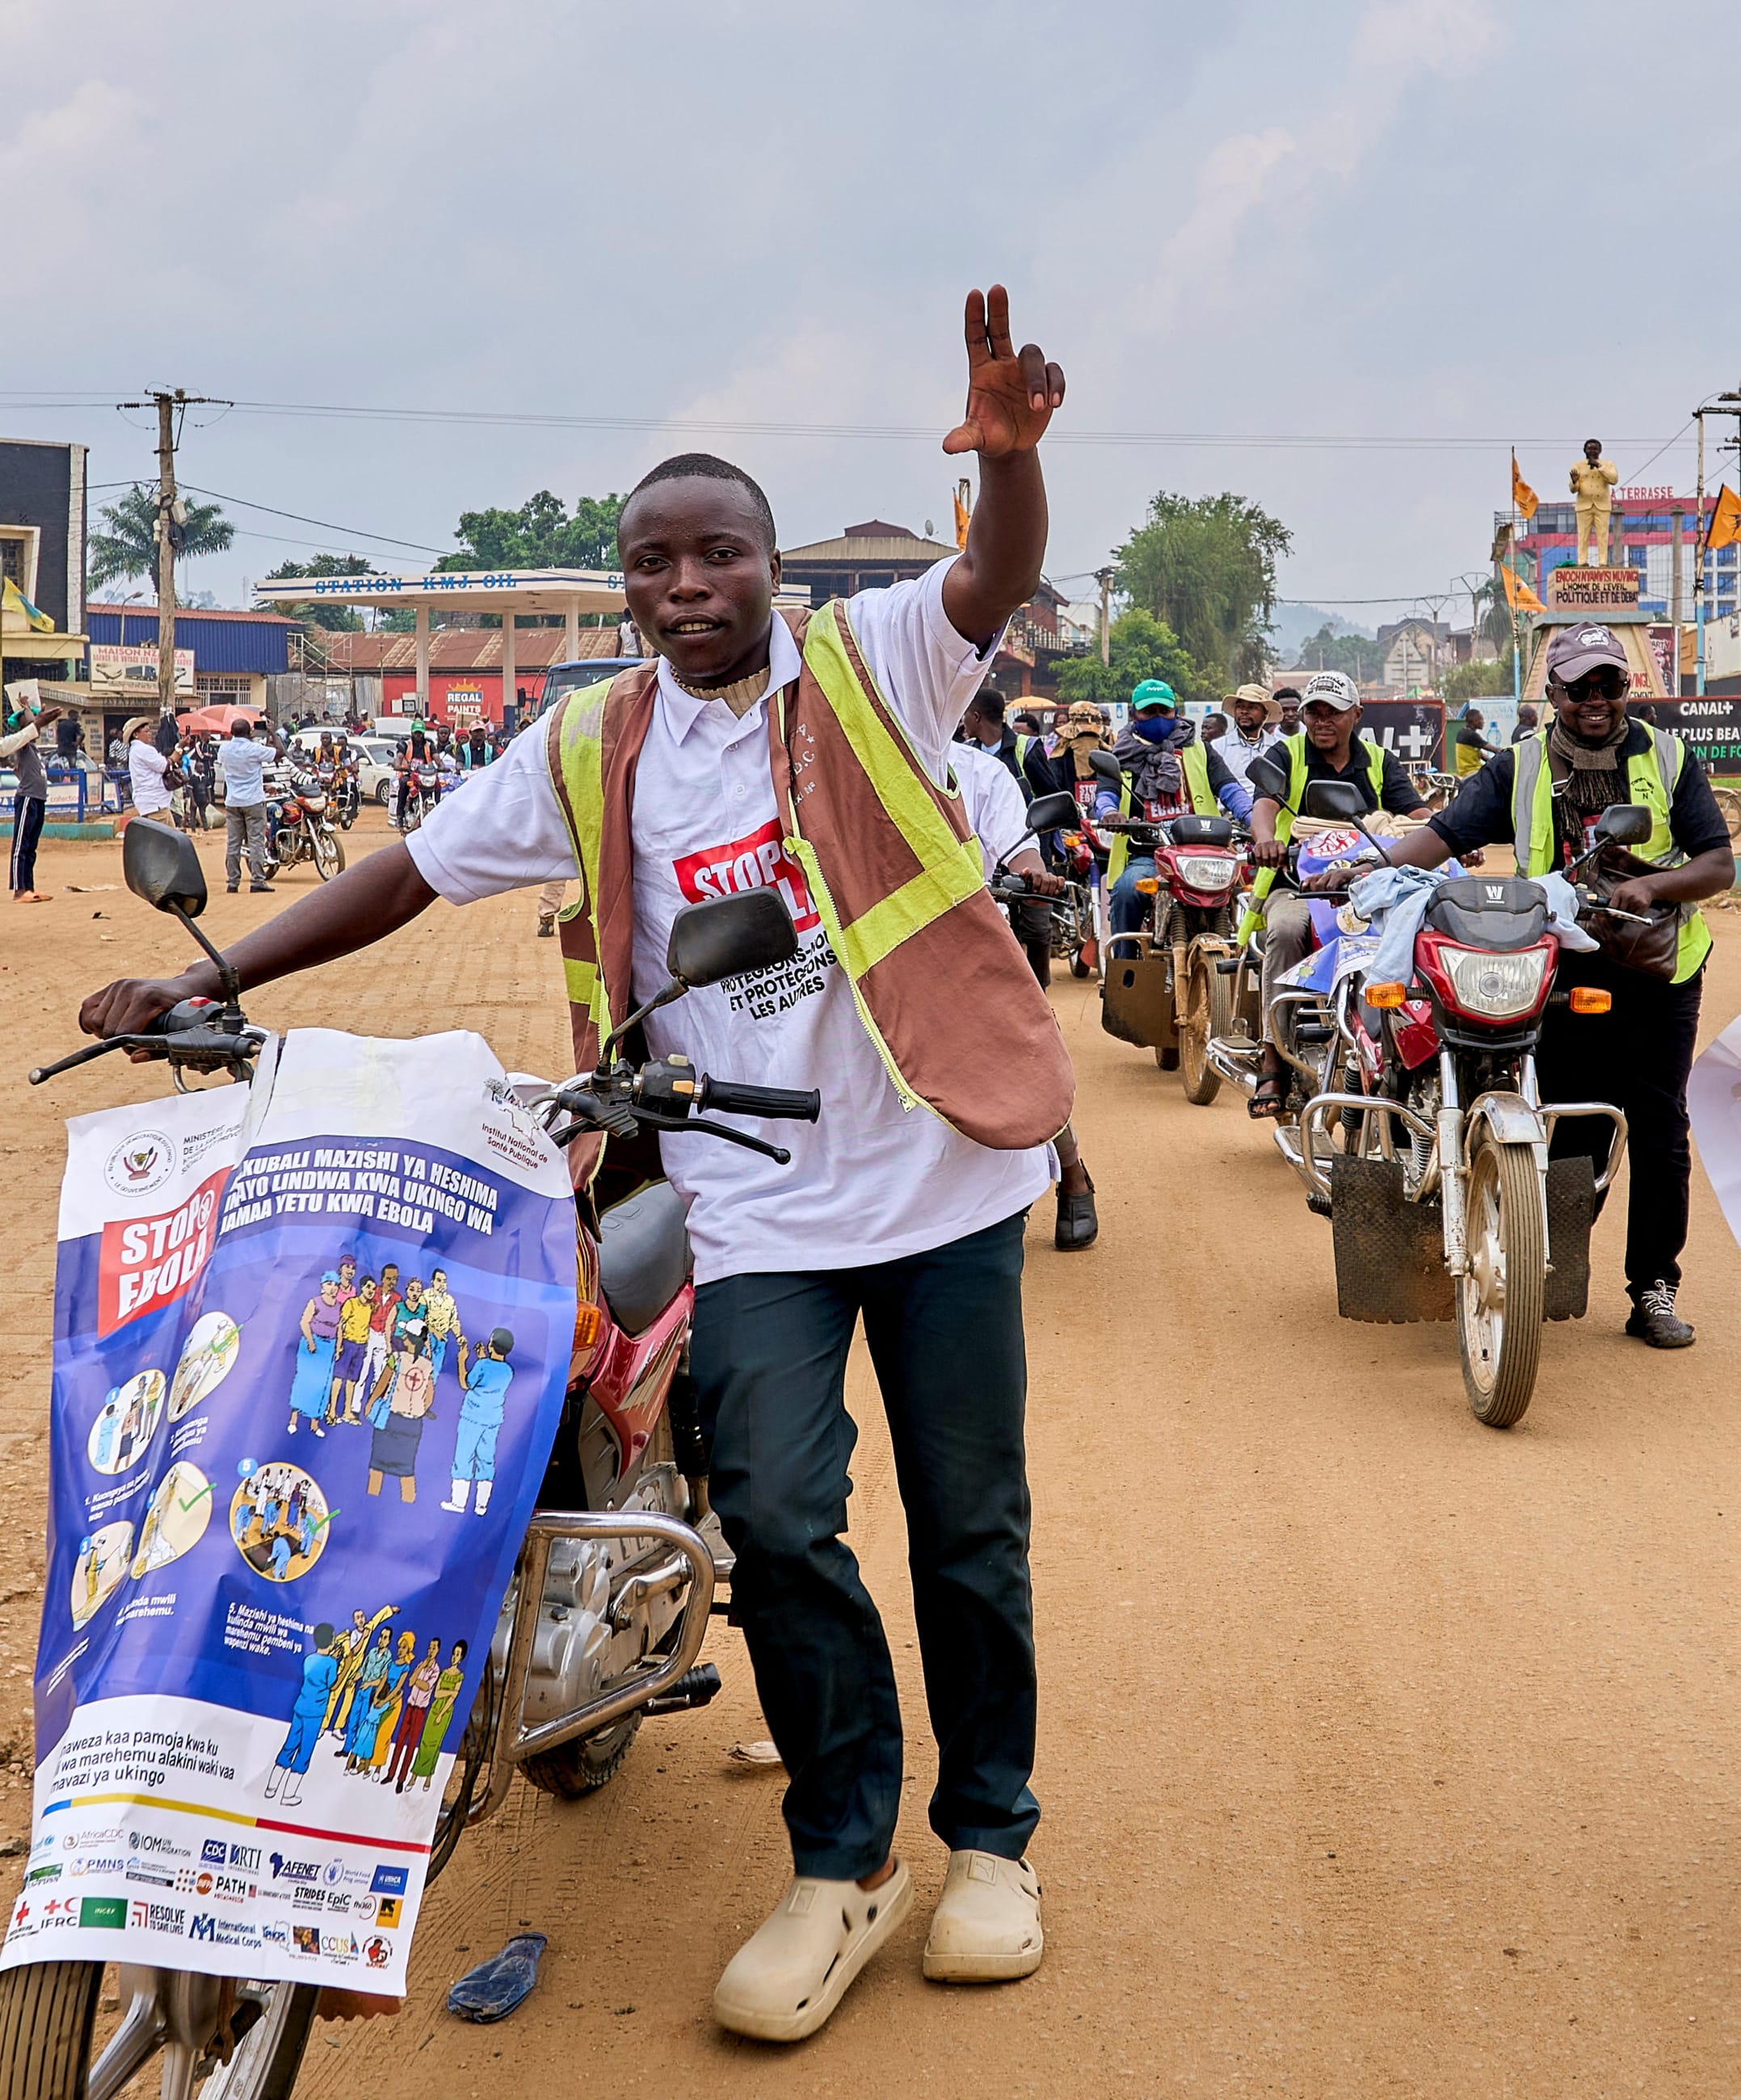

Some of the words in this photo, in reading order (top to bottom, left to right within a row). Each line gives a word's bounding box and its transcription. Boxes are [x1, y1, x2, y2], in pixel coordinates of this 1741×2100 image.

[1622, 486, 1674, 499] TERRASSE
[315, 577, 402, 594] STATION
[422, 574, 473, 590] KMJ.
[482, 573, 517, 589] OIL
[1556, 571, 1581, 583] ENOCH
[1592, 582, 1601, 591] DE
[1556, 591, 1600, 604] POLITIQUE
[1600, 591, 1609, 604] ET
[1612, 591, 1621, 603] DE
[98, 647, 141, 657] MAISON
[447, 692, 482, 703] REGAL
[447, 705, 482, 713] PAINTS
[1680, 701, 1734, 716] CANAL+
[1359, 724, 1432, 758] AL+
[1681, 728, 1714, 741] PLUS
[1717, 727, 1741, 741] BEA
[1711, 746, 1726, 758] DE
[694, 840, 781, 901] STOP
[730, 996, 743, 1011] ET
[749, 1000, 776, 1021] LES
[779, 976, 826, 1011] AUTRES
[183, 1146, 194, 1155] DE
[482, 1123, 507, 1141] Institut
[507, 1135, 539, 1158] National
[539, 1153, 548, 1163] de
[486, 1136, 508, 1153] Santé
[509, 1148, 539, 1170] Publique
[242, 1150, 310, 1177] KUBALI
[313, 1149, 398, 1172] MAZISHI
[403, 1154, 426, 1179] YA
[430, 1161, 498, 1211] HESHIMA
[271, 1171, 349, 1192] LINDWA
[353, 1170, 400, 1199] KWA
[402, 1180, 463, 1220] UKINGO
[466, 1210, 493, 1235] WA
[275, 1193, 322, 1213] YETU
[326, 1193, 373, 1218] KWA
[376, 1199, 435, 1235] EBOLA
[121, 1193, 201, 1265] STOP
[117, 1226, 208, 1320] EBOLA
[242, 1460, 251, 1472] 5
[150, 1594, 177, 1606] mwili
[226, 1614, 254, 1630] kulinda
[254, 1622, 277, 1636] mwili
[277, 1628, 288, 1638] wa
[229, 1602, 236, 1615] 5.
[238, 1603, 268, 1622] Mazishi
[267, 1614, 276, 1626] ya
[276, 1614, 304, 1632] heshima
[304, 1624, 314, 1635] na
[224, 1636, 249, 1649] wapenzi
[225, 1625, 261, 1643] marehemu
[293, 1642, 303, 1654] ya
[105, 1730, 129, 1746] kaa
[133, 1731, 183, 1751] pamoja
[186, 1733, 205, 1754] kwa
[206, 1738, 219, 1757] ku
[62, 1756, 77, 1773] wa
[79, 1748, 156, 1768] marehemu
[158, 1749, 197, 1772] alakini
[198, 1760, 219, 1778] waki
[219, 1764, 235, 1780] vaa
[51, 1771, 90, 1794] mavazi
[92, 1769, 110, 1787] ya
[115, 1764, 166, 1787] ukingo
[141, 1836, 162, 1852] IOM
[204, 1843, 225, 1858] CDC
[239, 1847, 263, 1869] RTI
[283, 1861, 322, 1878] AFENET
[345, 1869, 359, 1877] World
[216, 1876, 246, 1895] PATH
[294, 1886, 326, 1901] STRIDES
[326, 1892, 351, 1907] EpiC
[149, 1903, 186, 1925] RESOLVE
[40, 1916, 78, 1930] IFRC
[149, 1920, 156, 1930] TO
[157, 1922, 170, 1932] SAVE
[170, 1925, 184, 1935] LIVES
[217, 1918, 255, 1934] International
[216, 1932, 240, 1947] Medical
[242, 1936, 262, 1950] Corps
[321, 1936, 349, 1953] CCUS
